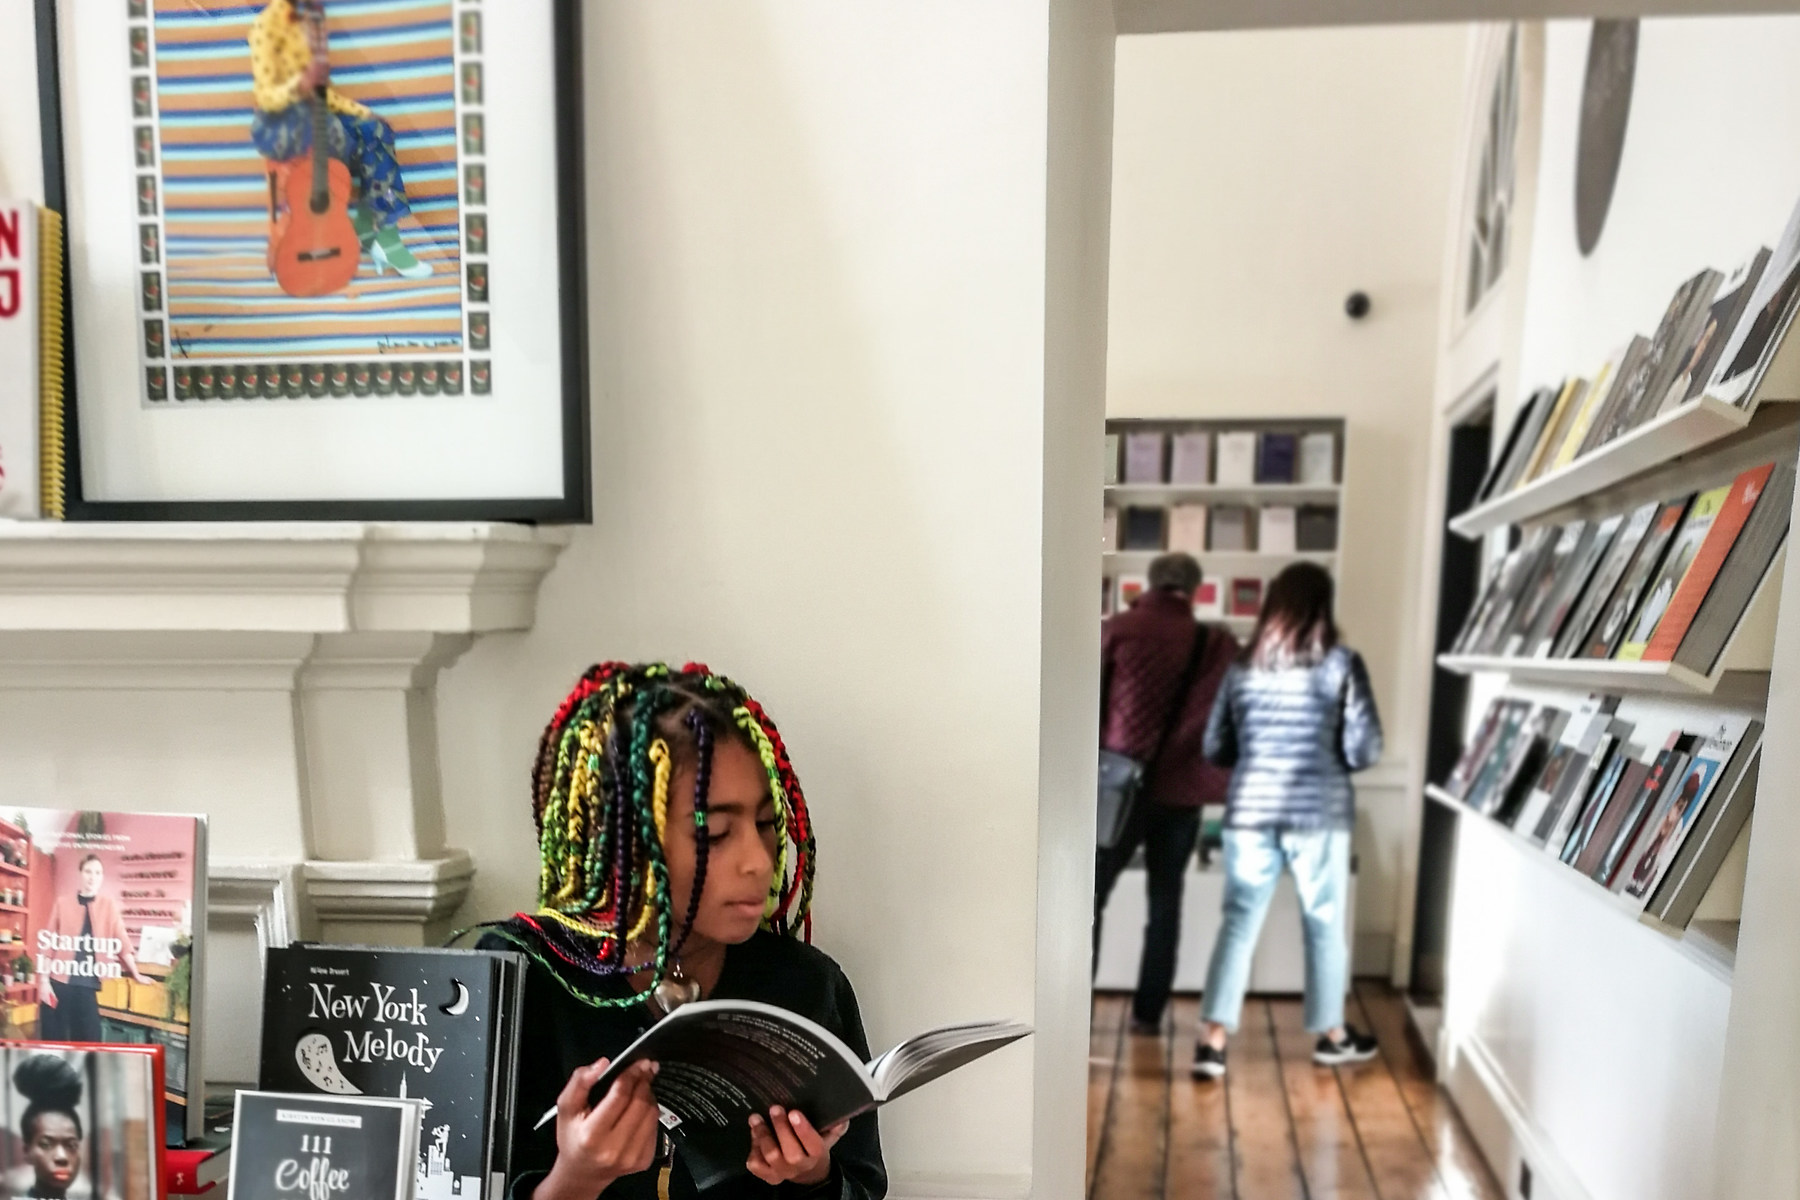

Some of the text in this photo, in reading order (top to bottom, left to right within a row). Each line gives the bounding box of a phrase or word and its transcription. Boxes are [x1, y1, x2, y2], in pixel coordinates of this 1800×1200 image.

[37, 929, 123, 956] Startup
[36, 954, 122, 978] London
[308, 981, 428, 1026] New York
[342, 1028, 444, 1073] Melody
[300, 1134, 332, 1154] 111
